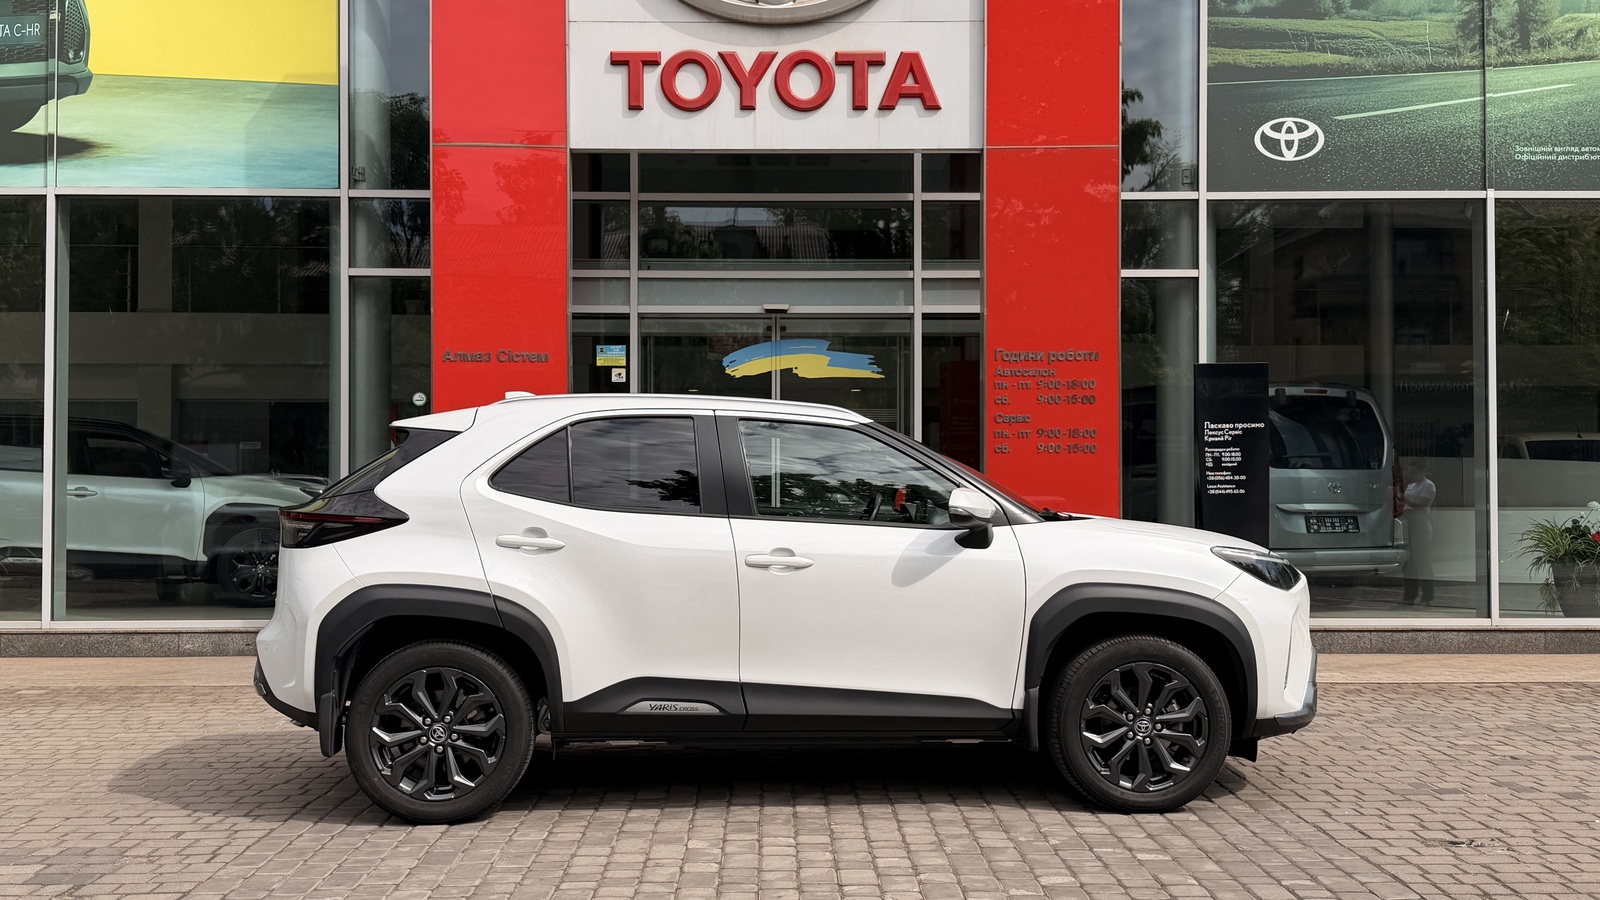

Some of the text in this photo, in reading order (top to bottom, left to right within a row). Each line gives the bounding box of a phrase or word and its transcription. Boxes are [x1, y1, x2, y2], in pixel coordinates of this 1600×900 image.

[13, 23, 41, 37] C-HR
[610, 50, 942, 112] TOYOTA
[1514, 144, 1553, 152] Зовнішній
[1514, 153, 1557, 161] Офіційний
[442, 349, 549, 363] Алмаз Сістем
[994, 348, 1099, 365] Години роботи
[994, 366, 1056, 377] Автосалон
[1036, 394, 1097, 405] 9:00-15:00
[994, 412, 1032, 425] Сервіс
[1235, 422, 1265, 430] просимо
[1036, 427, 1098, 439] 9:00-18:00
[1036, 443, 1098, 455] 9:00-15:00
